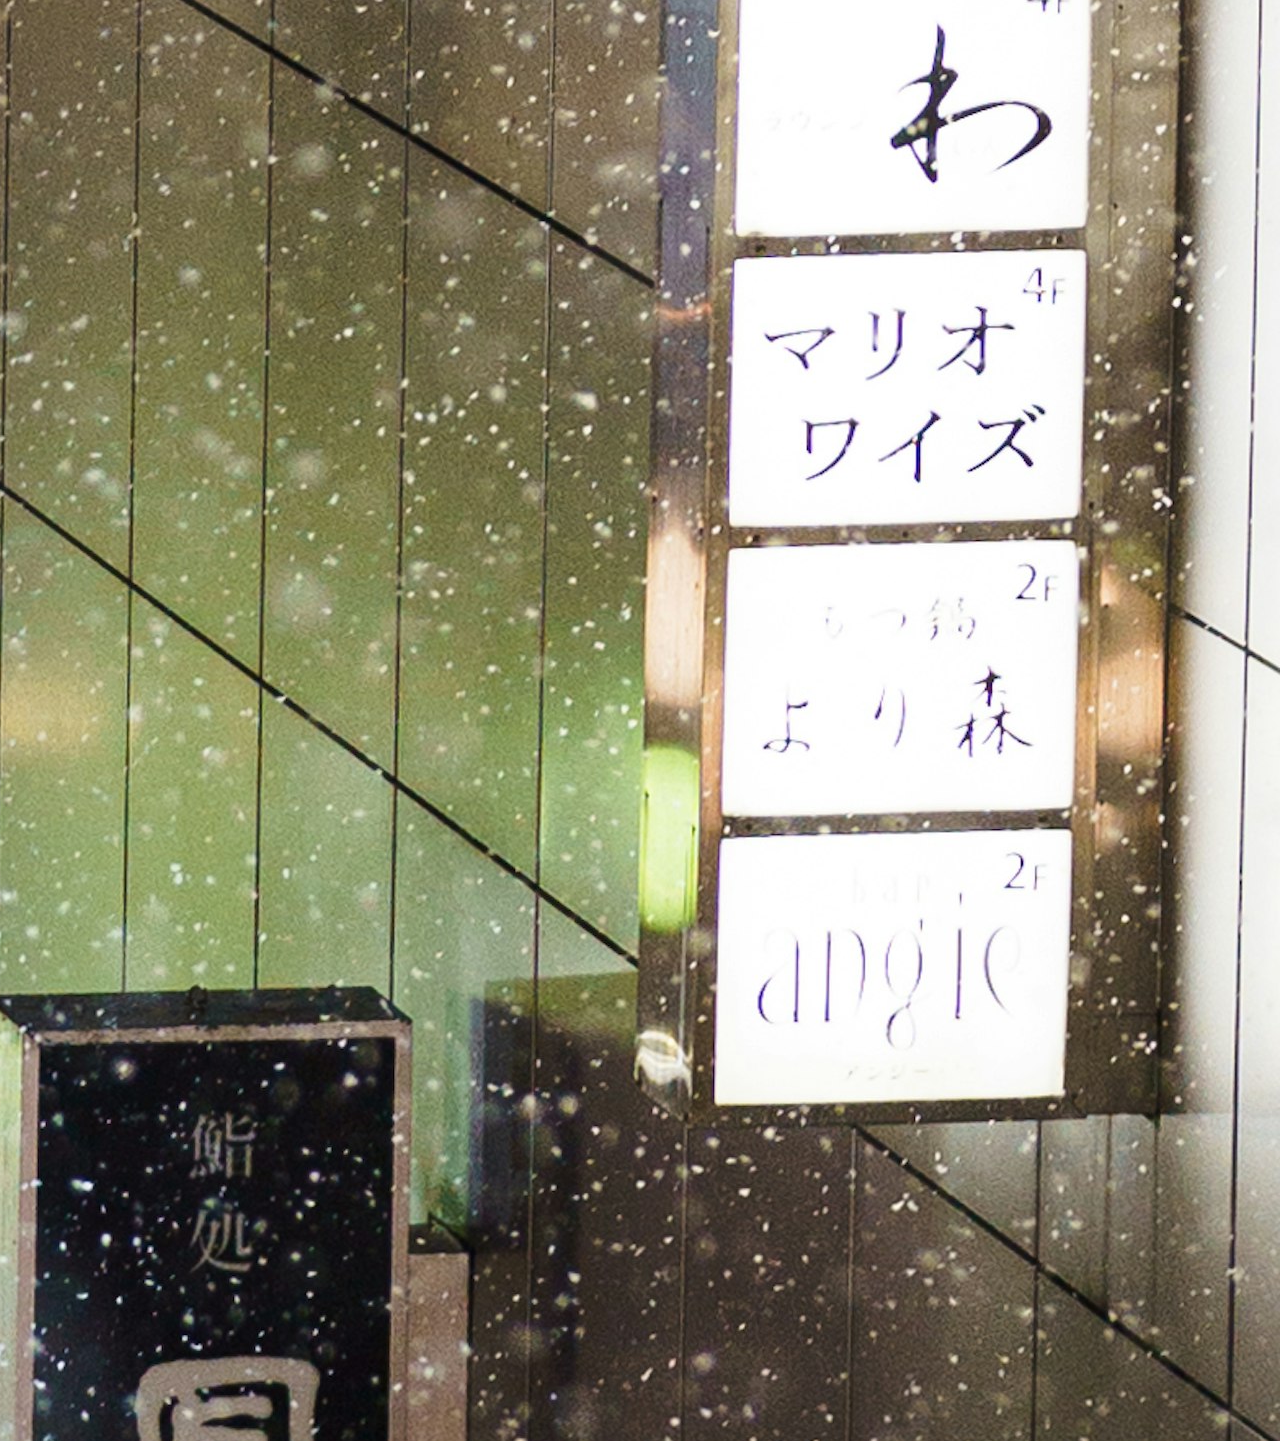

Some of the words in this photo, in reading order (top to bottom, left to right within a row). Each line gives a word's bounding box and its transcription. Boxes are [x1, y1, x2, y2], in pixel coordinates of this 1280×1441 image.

[1023, 267, 1065, 305] 4F
[764, 306, 1015, 380] マリオ
[804, 404, 1046, 483] ワイズ
[1015, 563, 1059, 602] 2F
[1004, 852, 1047, 891] 2F
[757, 891, 1021, 1049] angie
